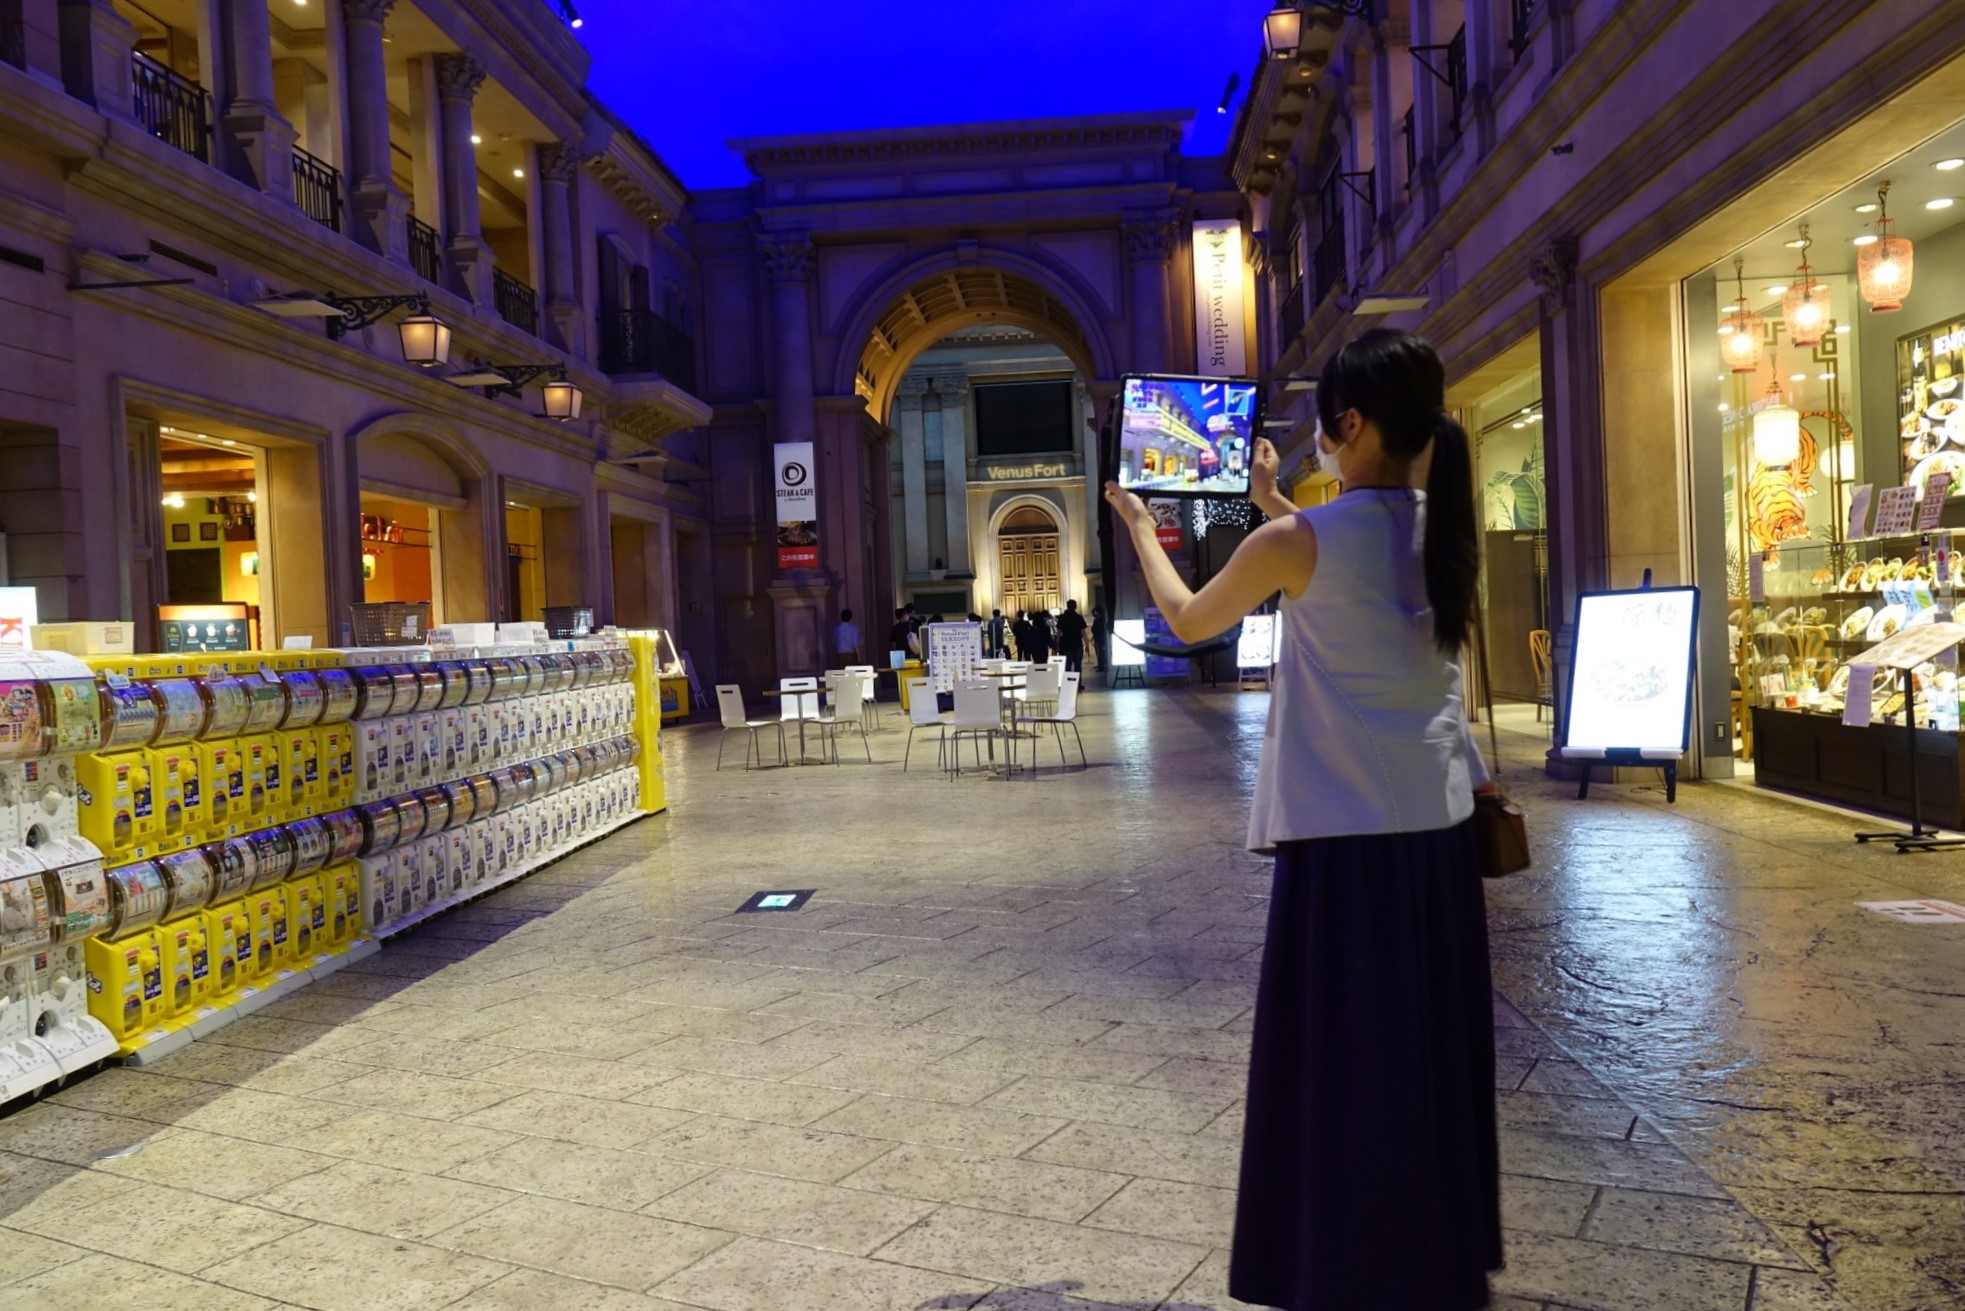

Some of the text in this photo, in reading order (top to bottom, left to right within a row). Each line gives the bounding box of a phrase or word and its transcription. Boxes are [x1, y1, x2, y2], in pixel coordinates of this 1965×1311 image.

[1210, 253, 1228, 366] Petit wedding
[776, 489, 794, 497] STEAK
[800, 488, 814, 496] CAFE
